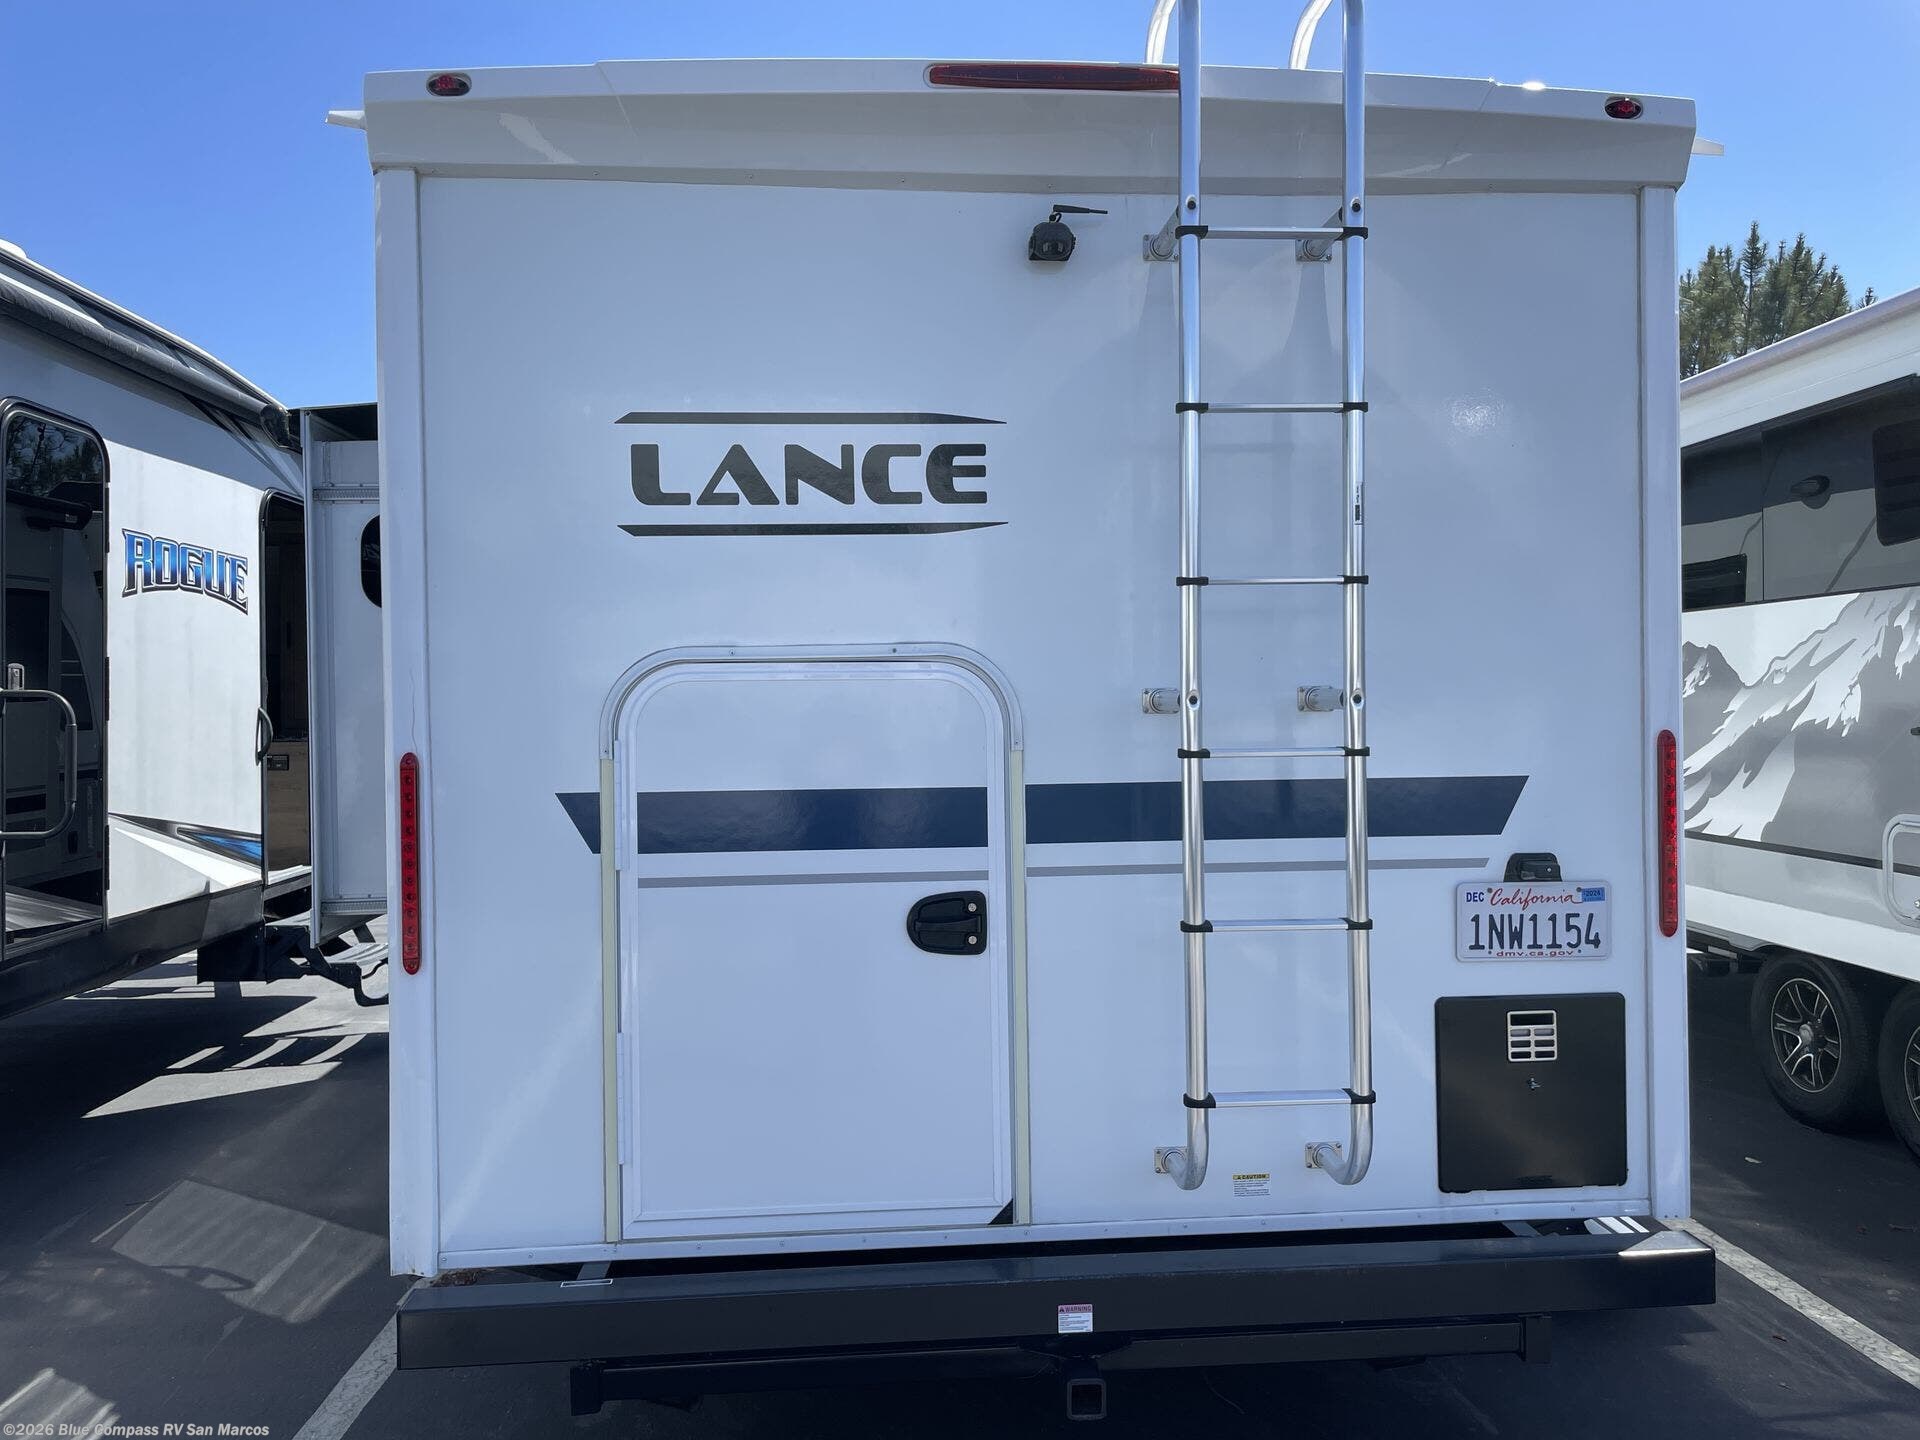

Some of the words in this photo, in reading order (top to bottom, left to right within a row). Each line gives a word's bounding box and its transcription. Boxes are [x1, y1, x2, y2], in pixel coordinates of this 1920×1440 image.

[630, 443, 987, 505] LANCE
[122, 528, 248, 615] ROGUE
[1466, 892, 1485, 903] DEC
[1490, 887, 1583, 910] California
[1468, 913, 1601, 950] 1NW1154
